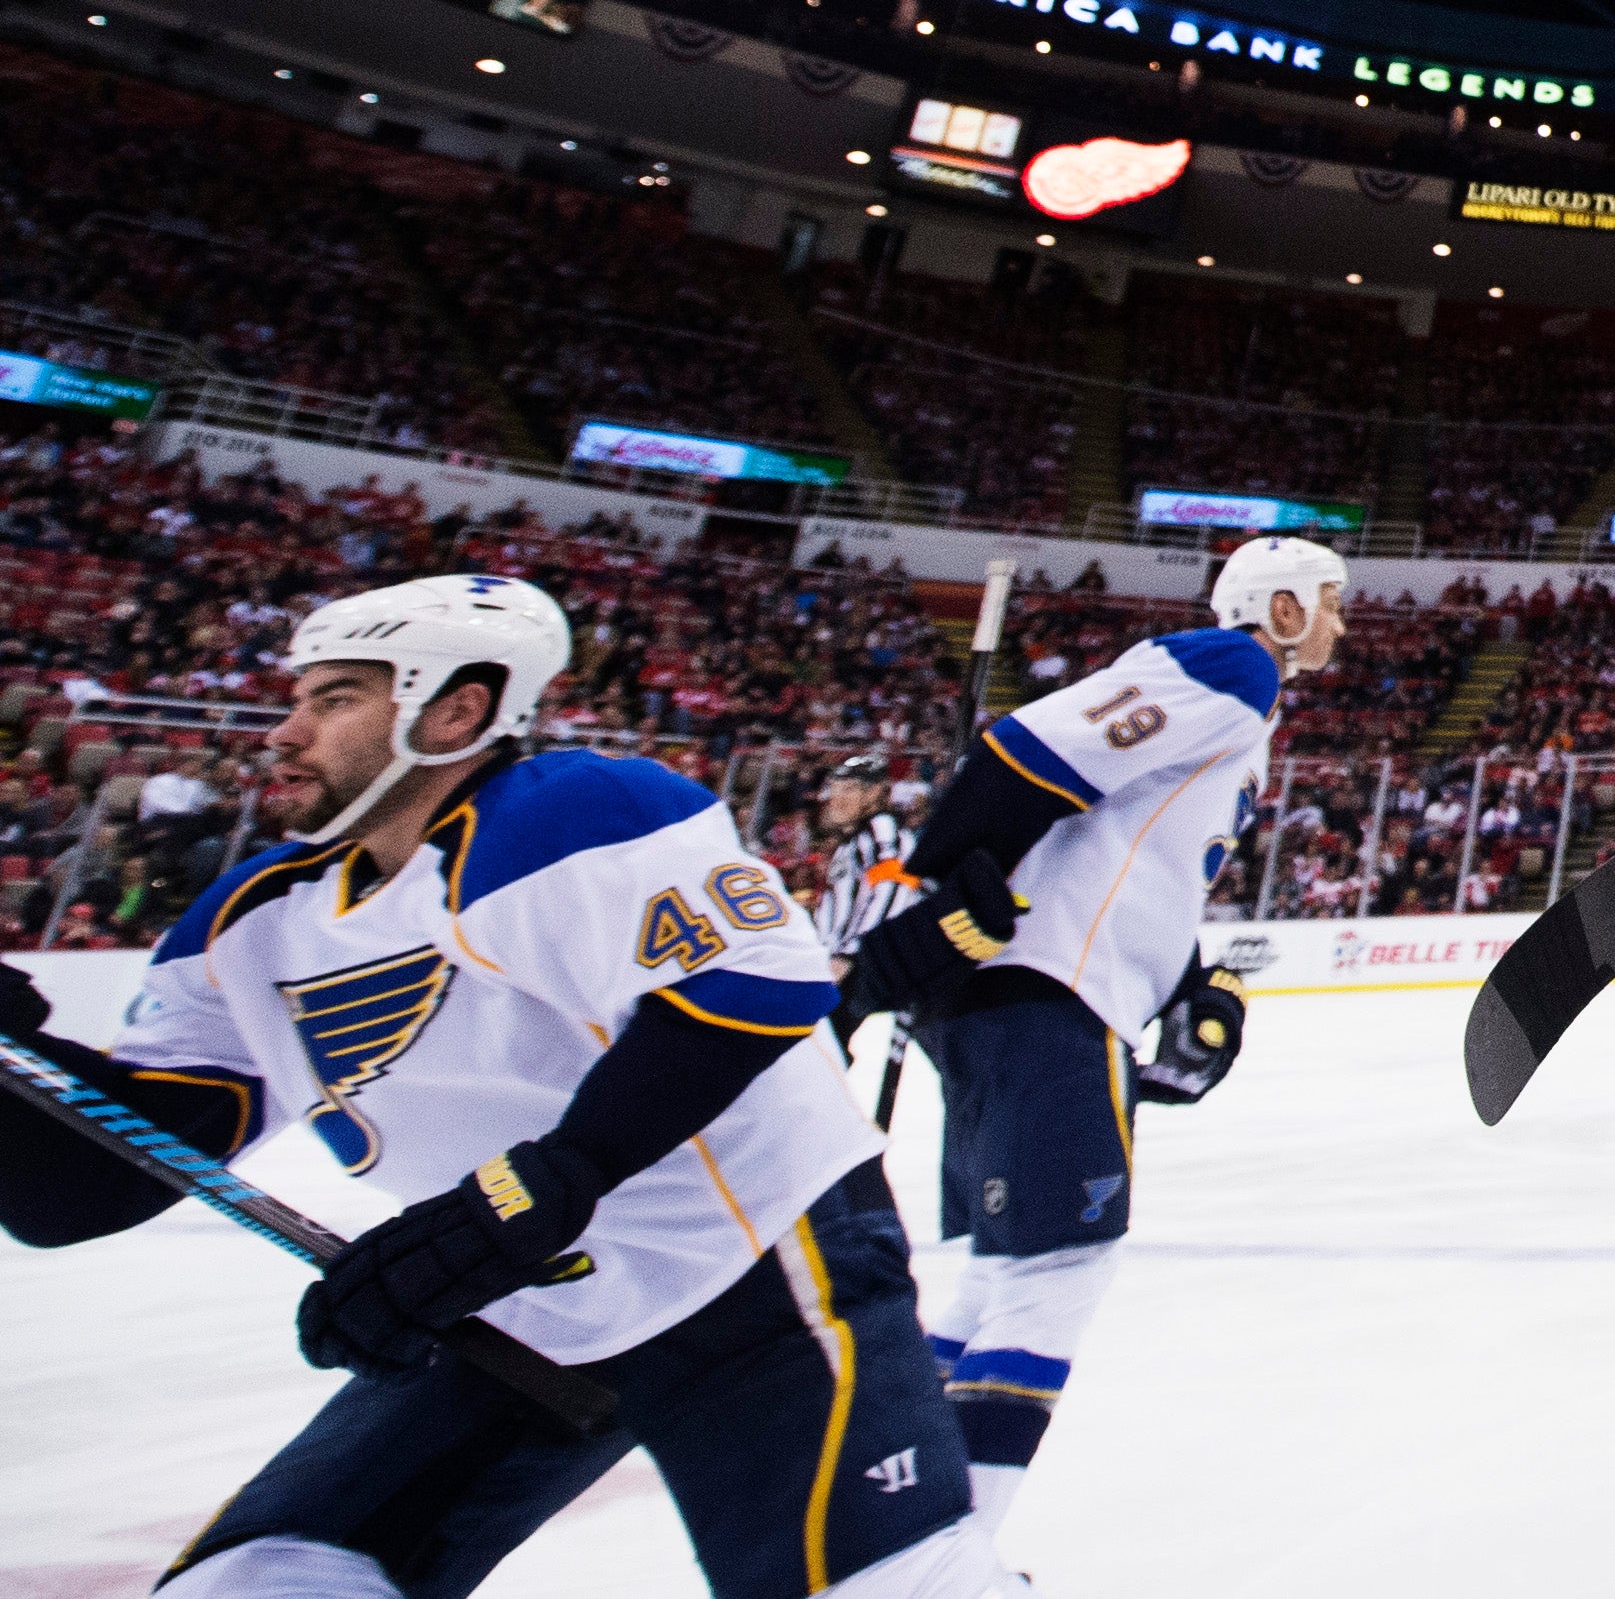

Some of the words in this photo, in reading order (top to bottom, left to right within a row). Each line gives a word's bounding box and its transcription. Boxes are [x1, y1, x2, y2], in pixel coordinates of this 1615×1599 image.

[1169, 20, 1324, 71] BANK
[1353, 55, 1595, 108] LEGENDS
[1467, 181, 1542, 207] LIPARI
[1543, 189, 1591, 210] OLD
[1082, 685, 1168, 752] 19
[635, 862, 789, 972] 46
[1367, 940, 1461, 966] BELLE
